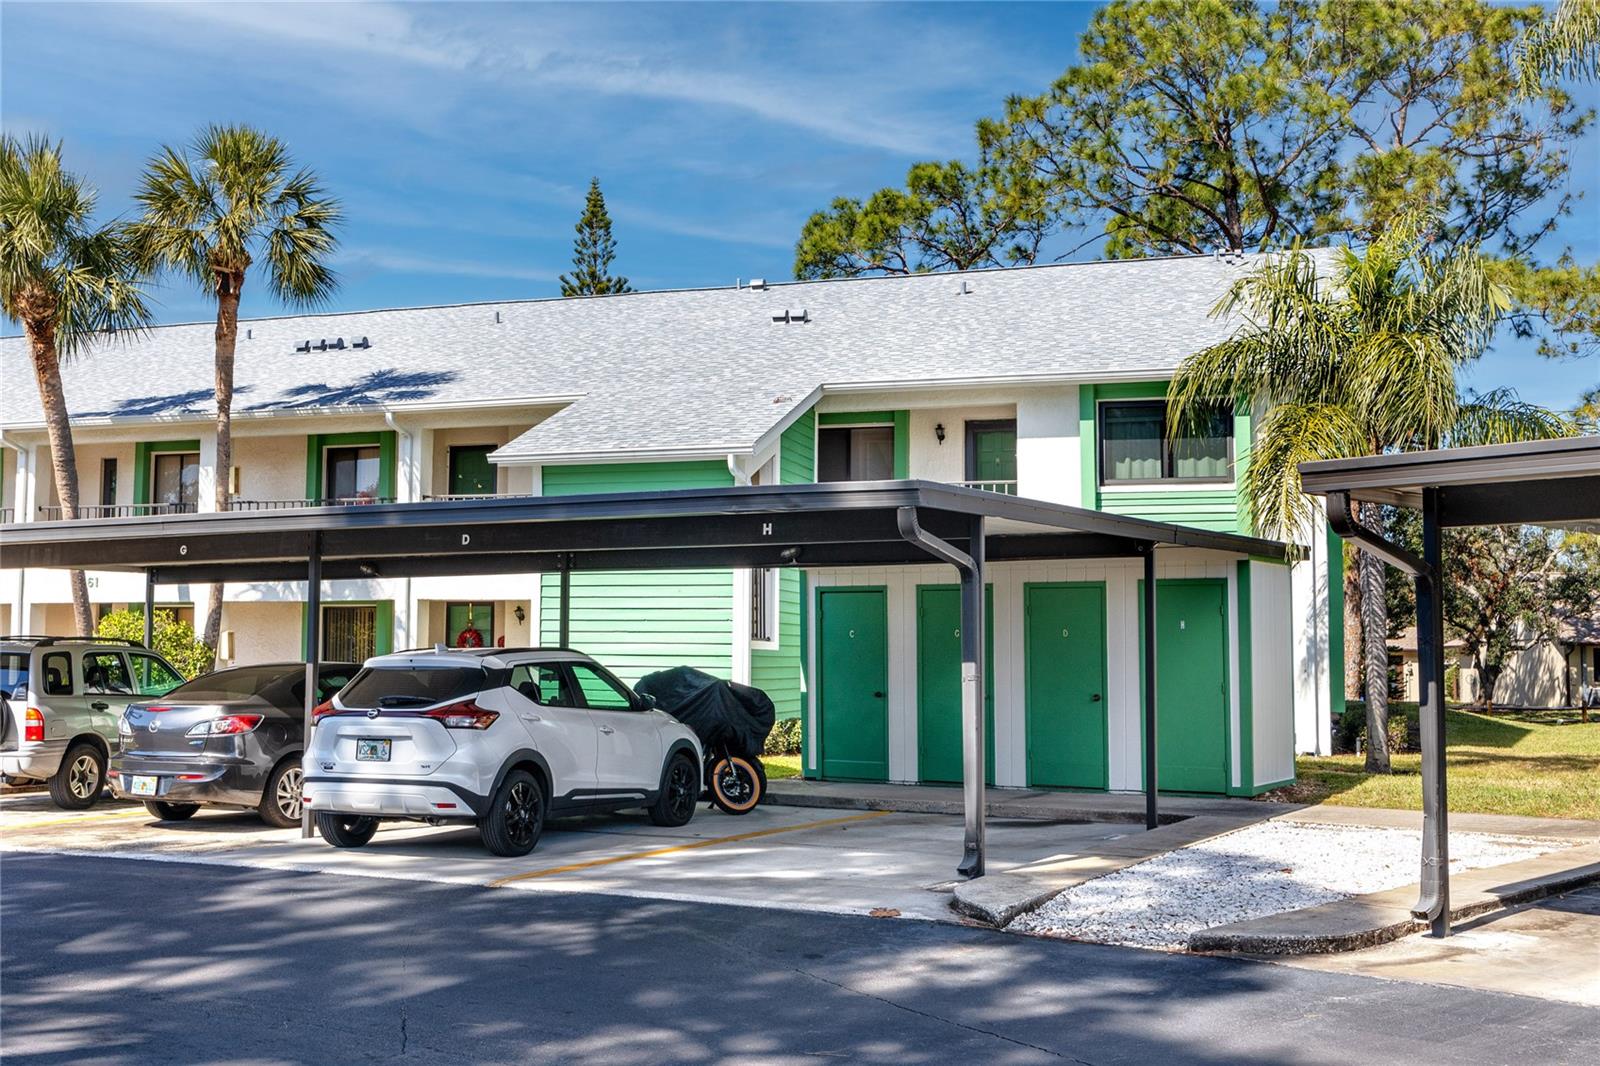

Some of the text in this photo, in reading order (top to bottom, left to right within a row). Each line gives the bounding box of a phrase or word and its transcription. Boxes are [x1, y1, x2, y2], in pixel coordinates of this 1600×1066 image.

[762, 523, 772, 535] H
[461, 534, 470, 546] D
[179, 545, 187, 555] G
[849, 629, 855, 639] C
[1062, 629, 1069, 638] D
